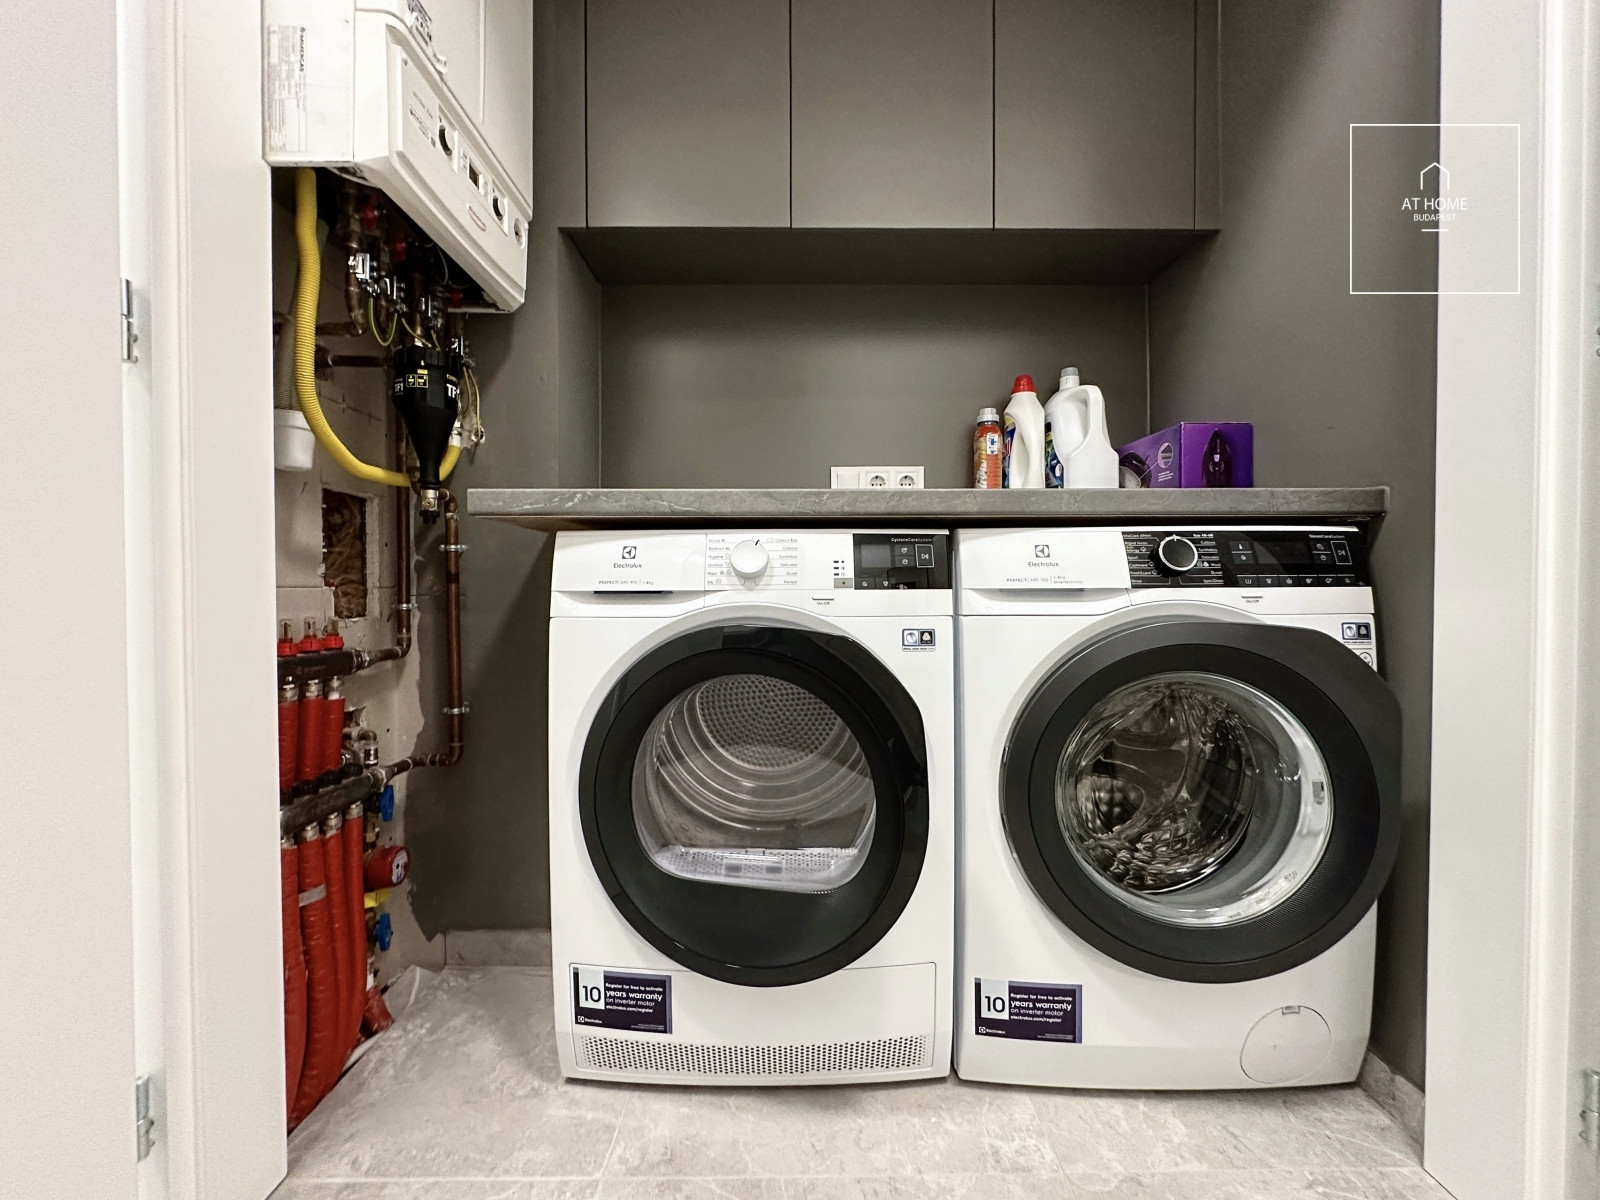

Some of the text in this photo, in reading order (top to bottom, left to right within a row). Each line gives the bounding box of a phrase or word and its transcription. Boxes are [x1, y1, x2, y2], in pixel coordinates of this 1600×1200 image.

[582, 985, 602, 1003] 10
[605, 990, 663, 1001] years warranty
[605, 1005, 654, 1013] electrolux.com/register
[984, 995, 1006, 1013] 10
[1010, 1000, 1072, 1011] years warranty
[1010, 1014, 1062, 1023] electrolux.com/register
